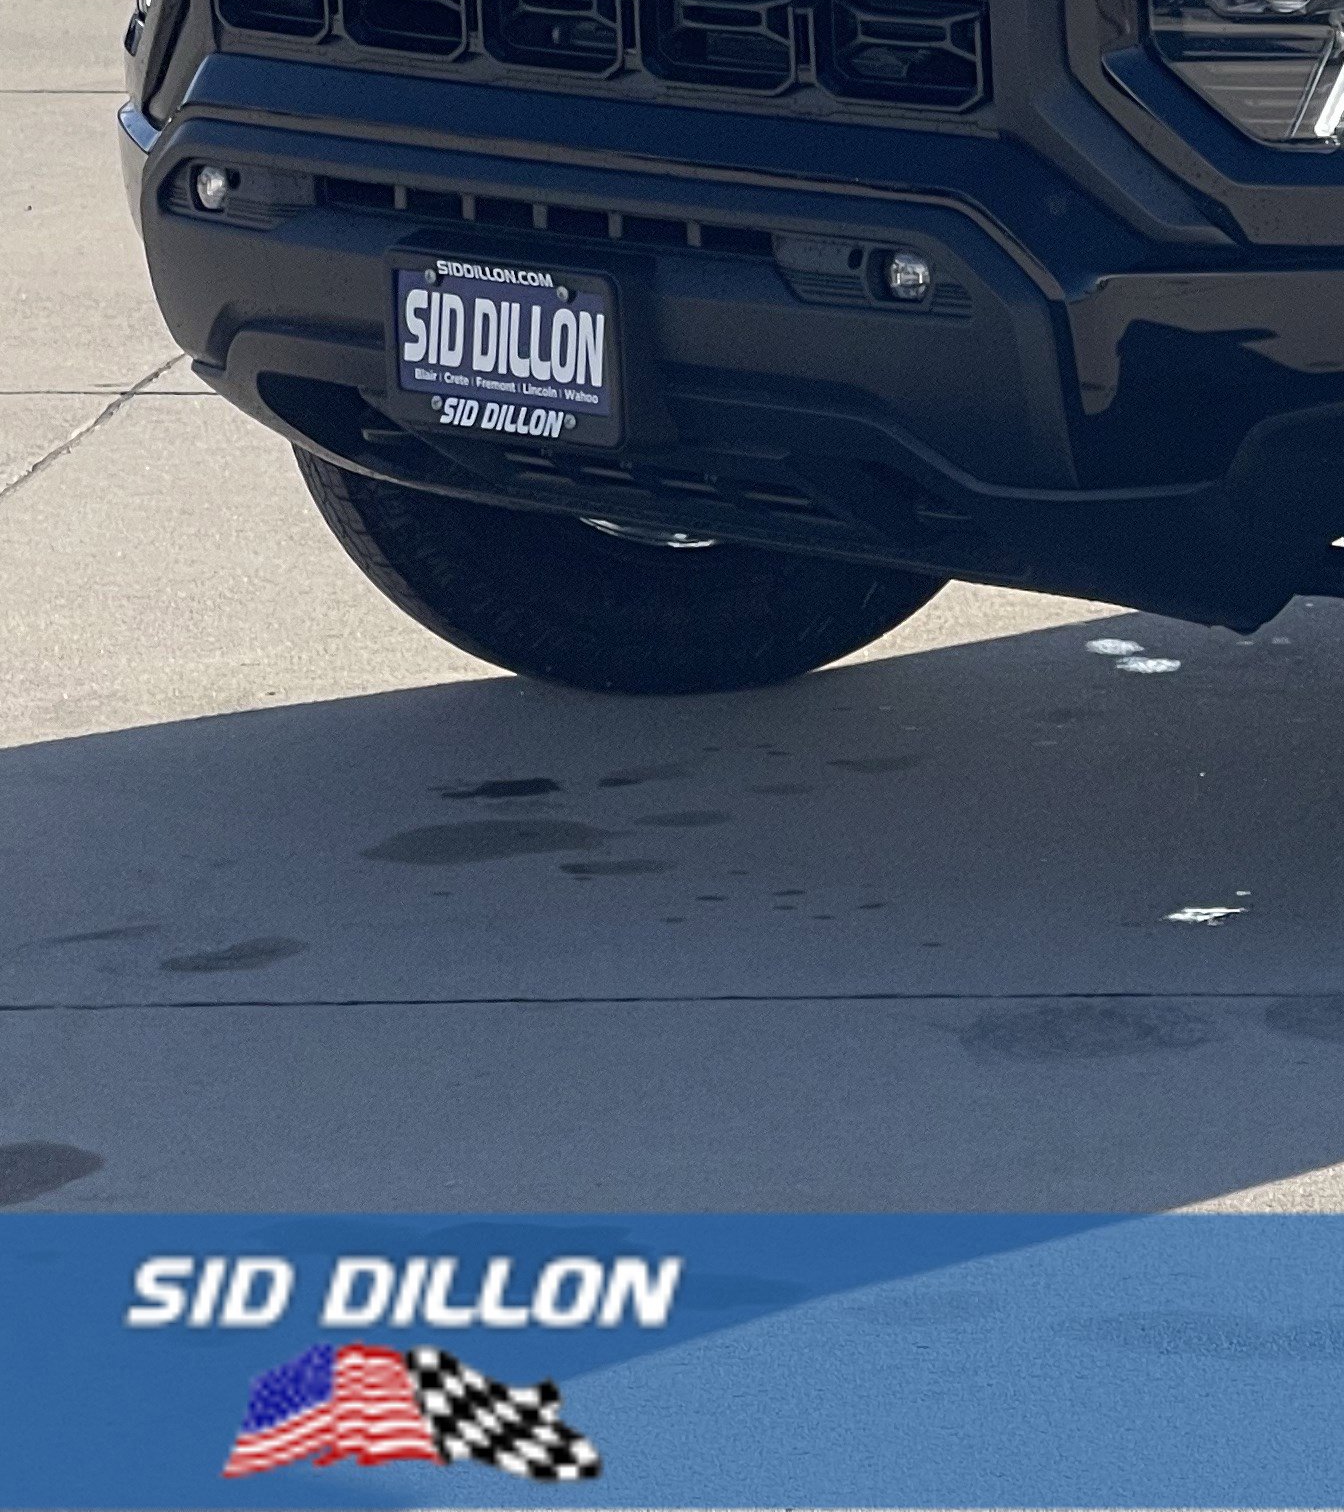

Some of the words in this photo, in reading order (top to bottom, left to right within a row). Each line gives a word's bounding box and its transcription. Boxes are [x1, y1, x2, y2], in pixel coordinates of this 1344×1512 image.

[436, 260, 554, 288] SIDDILLON.COM
[404, 289, 465, 367] SID
[472, 298, 604, 387] DILLON
[522, 383, 558, 398] Lincoln
[564, 389, 599, 404] Wahoo
[440, 397, 479, 426] SID
[481, 403, 564, 437] DILLON
